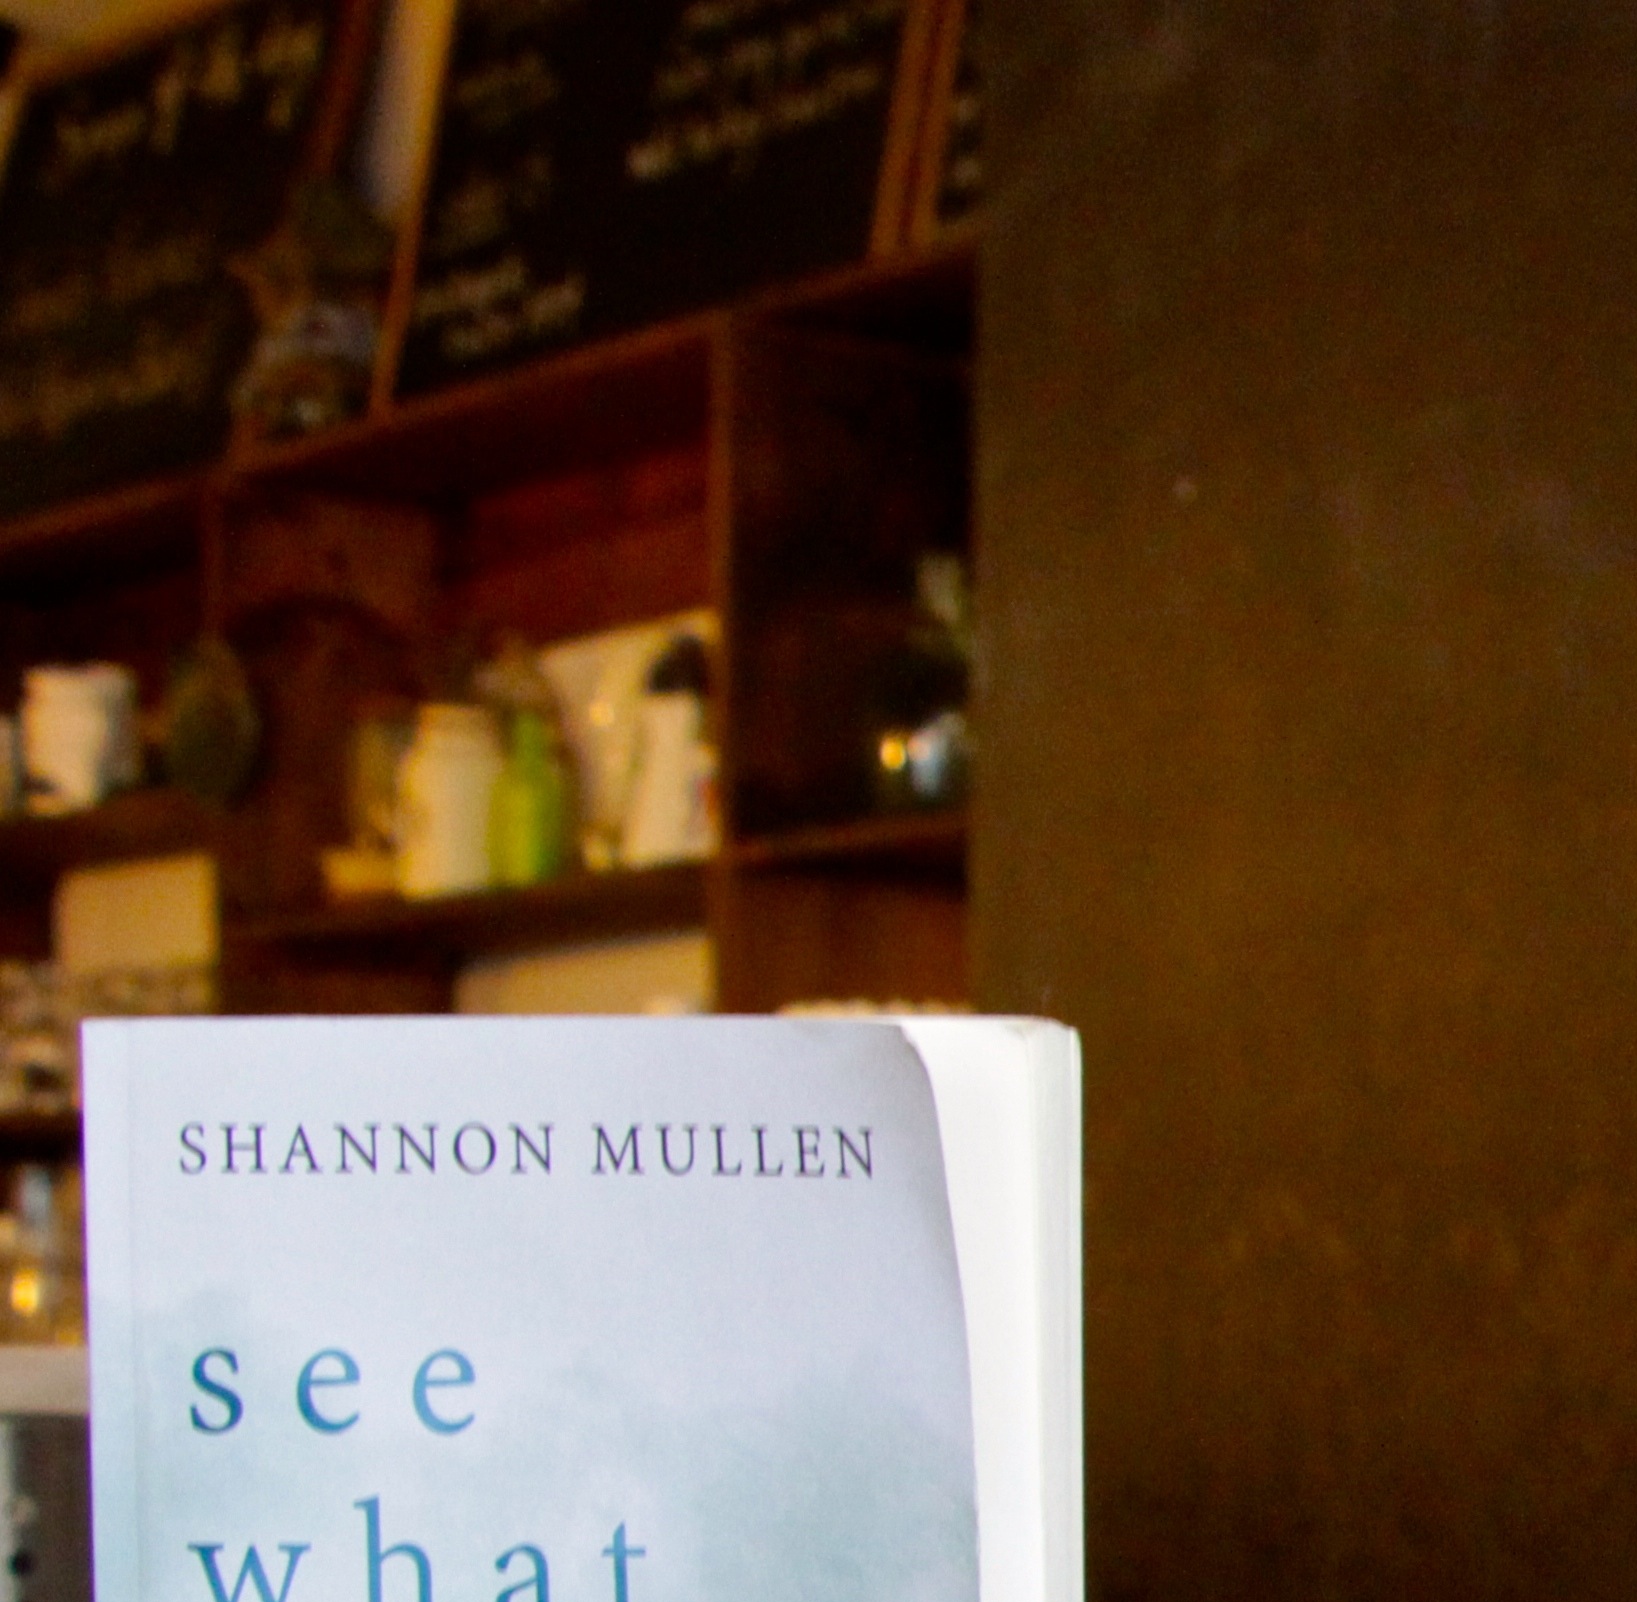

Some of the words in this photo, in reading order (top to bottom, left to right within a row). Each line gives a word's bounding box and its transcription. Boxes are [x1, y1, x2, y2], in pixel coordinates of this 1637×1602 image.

[178, 1121, 556, 1177] SHANNON
[591, 1122, 876, 1180] MULLEN
[189, 1345, 477, 1436] see
